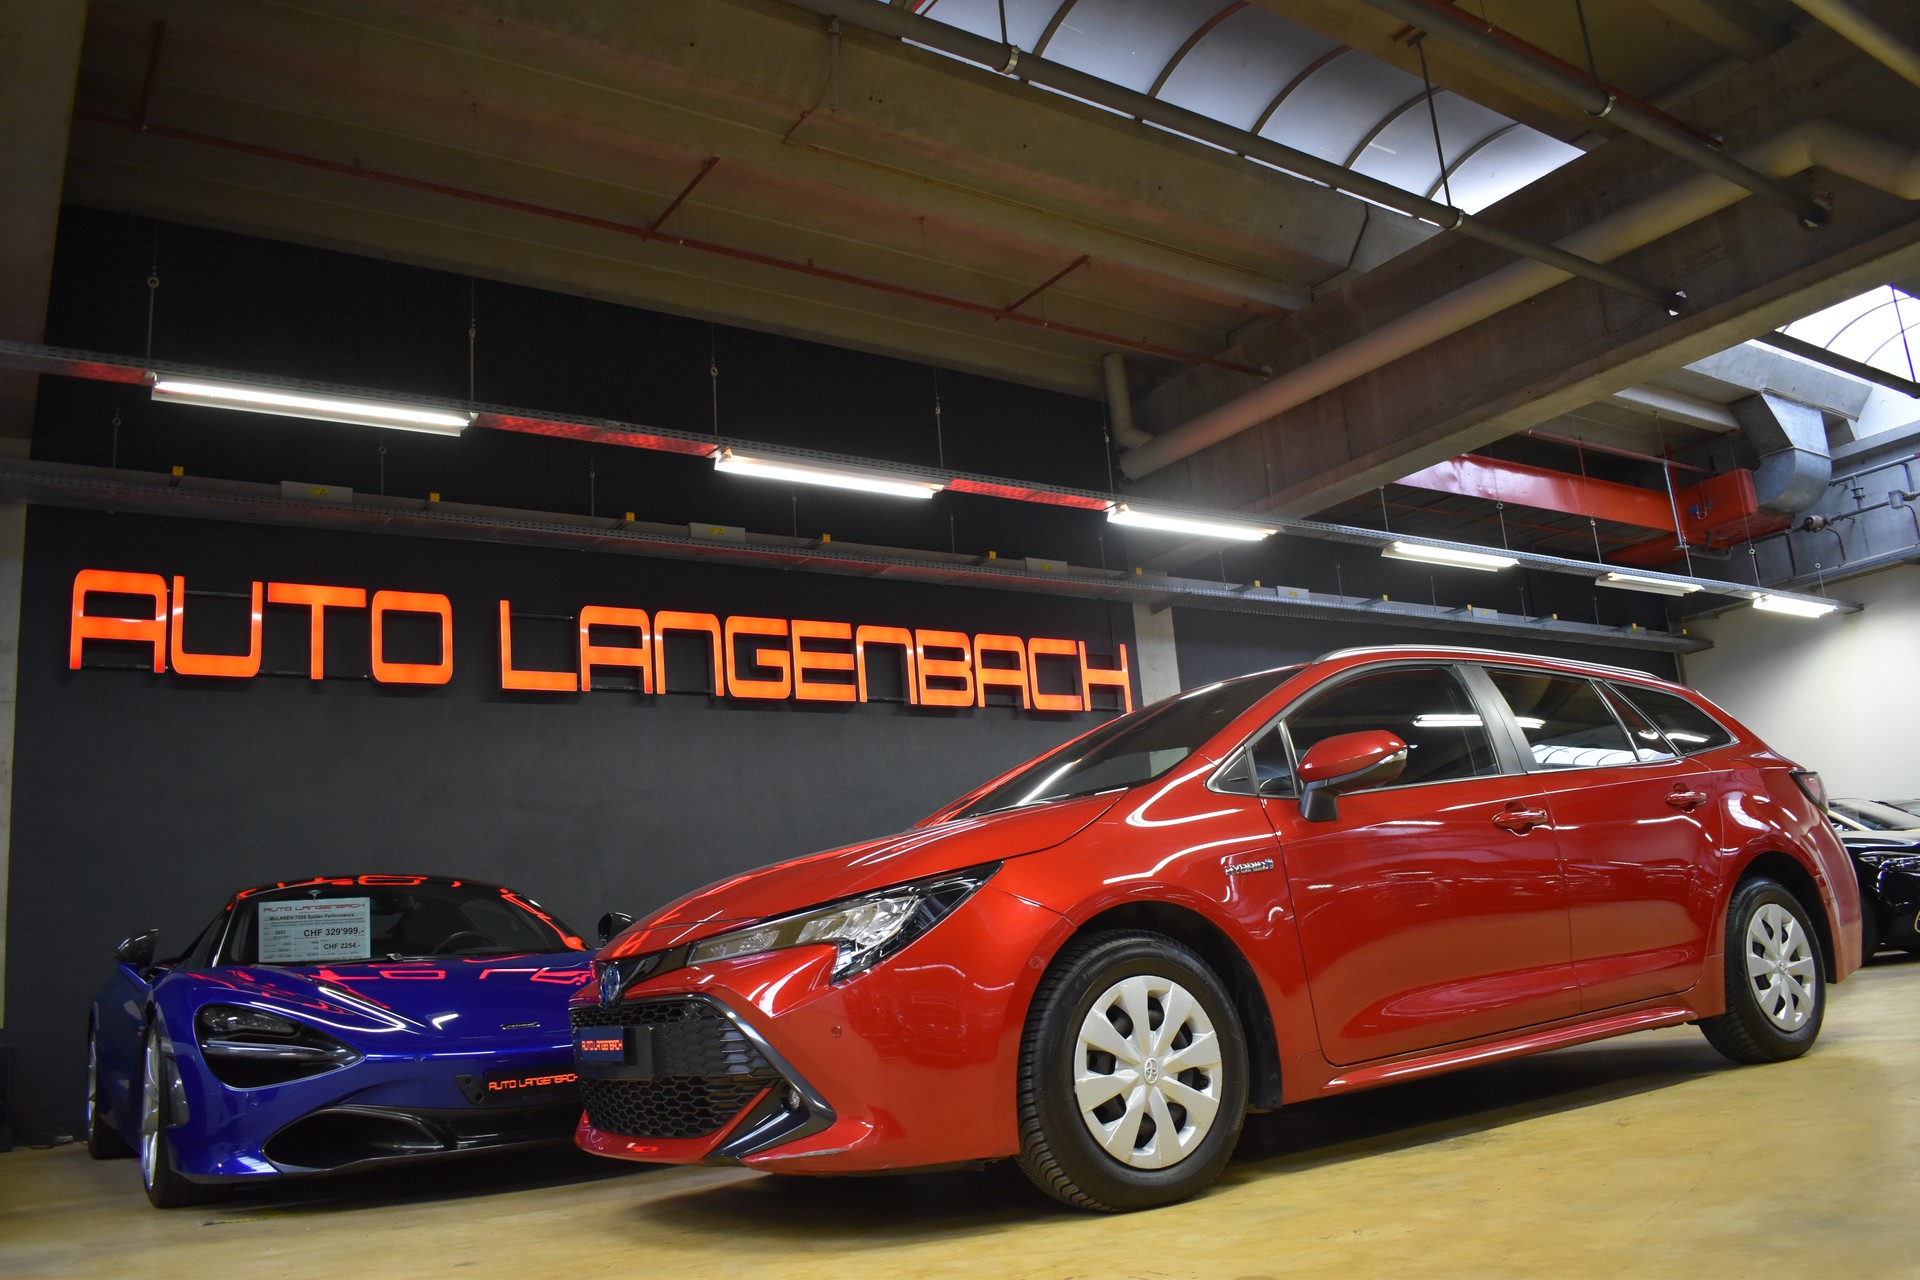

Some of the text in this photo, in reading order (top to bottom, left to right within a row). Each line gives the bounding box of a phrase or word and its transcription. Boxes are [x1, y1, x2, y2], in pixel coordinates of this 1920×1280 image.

[70, 569, 1129, 713] AUTO LANGENBACH
[303, 929, 323, 937] CHF
[489, 1079, 516, 1091] AUTO
